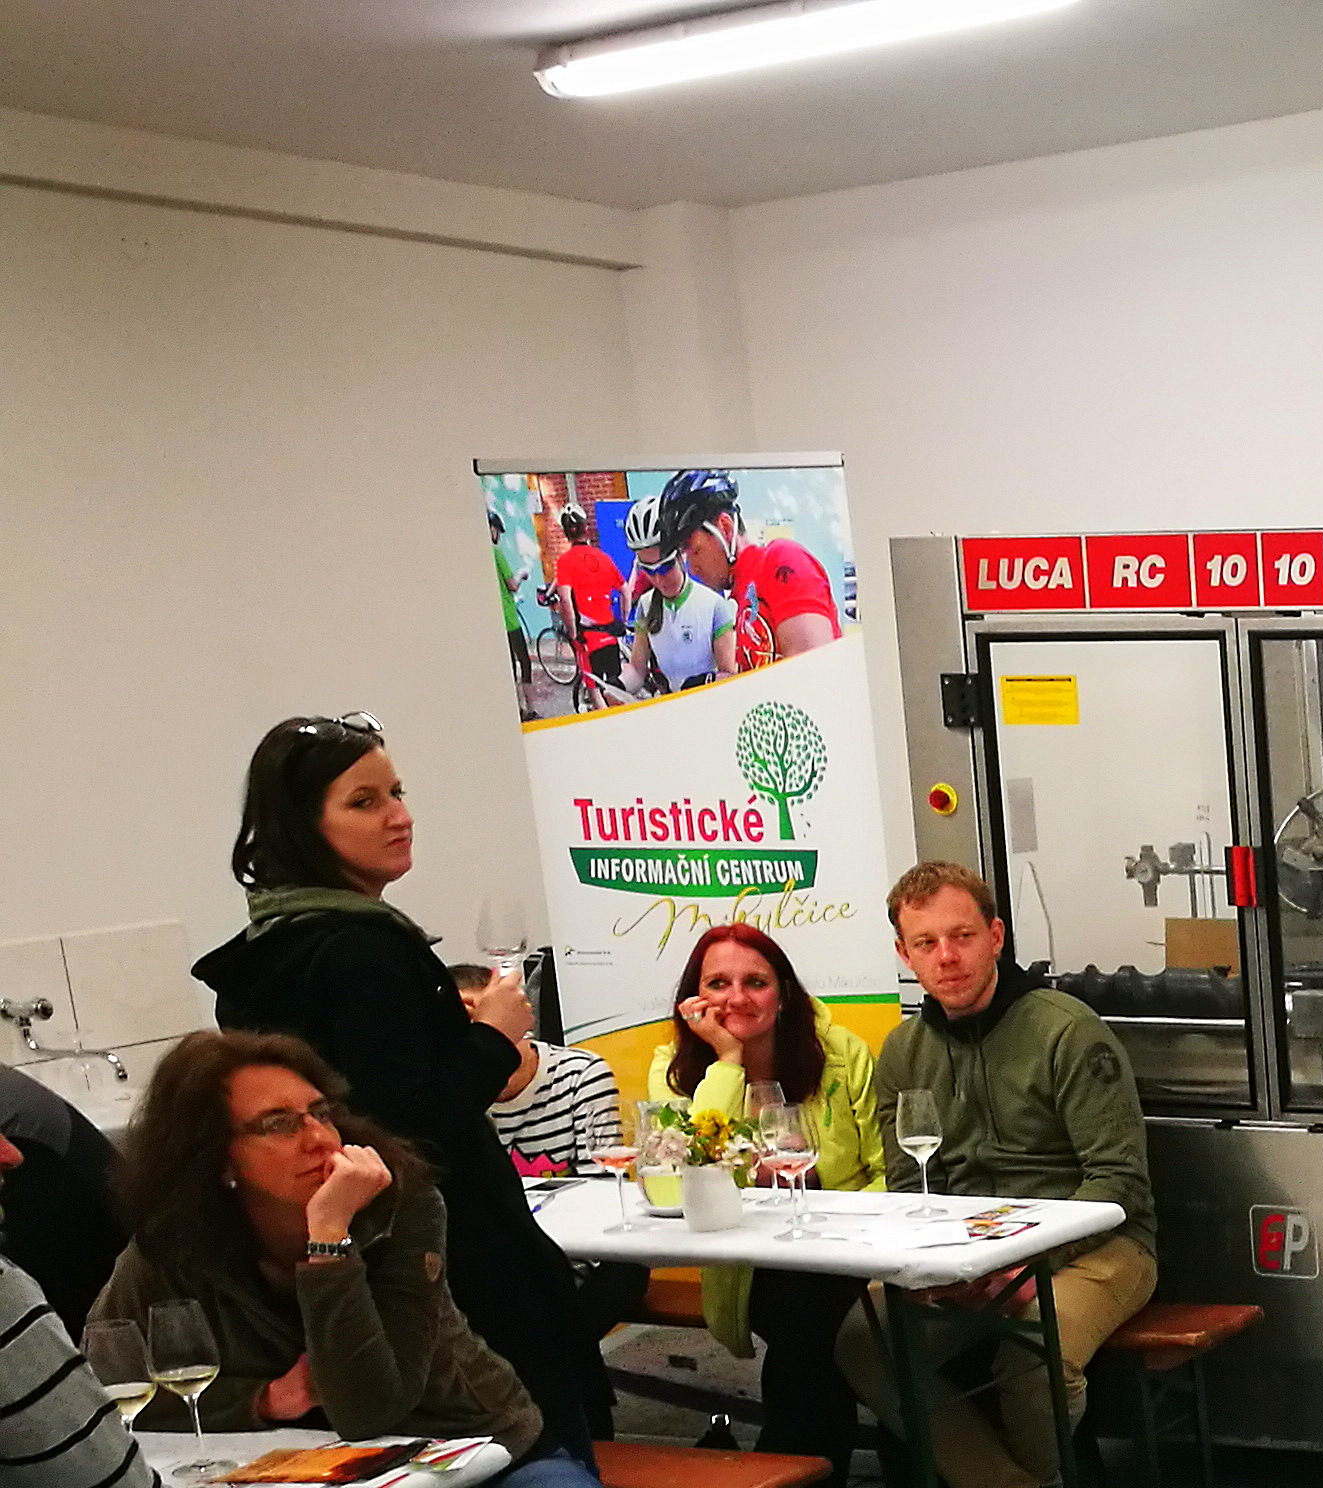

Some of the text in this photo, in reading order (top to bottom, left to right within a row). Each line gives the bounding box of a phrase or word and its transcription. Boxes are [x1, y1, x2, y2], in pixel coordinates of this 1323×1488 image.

[976, 556, 1074, 591] LUCA
[1112, 554, 1167, 588] RC
[1205, 553, 1248, 587] 10
[1273, 552, 1316, 586] 10
[573, 794, 764, 842] Turistické
[589, 854, 805, 887] INFORMAČNÍ CENTRUM
